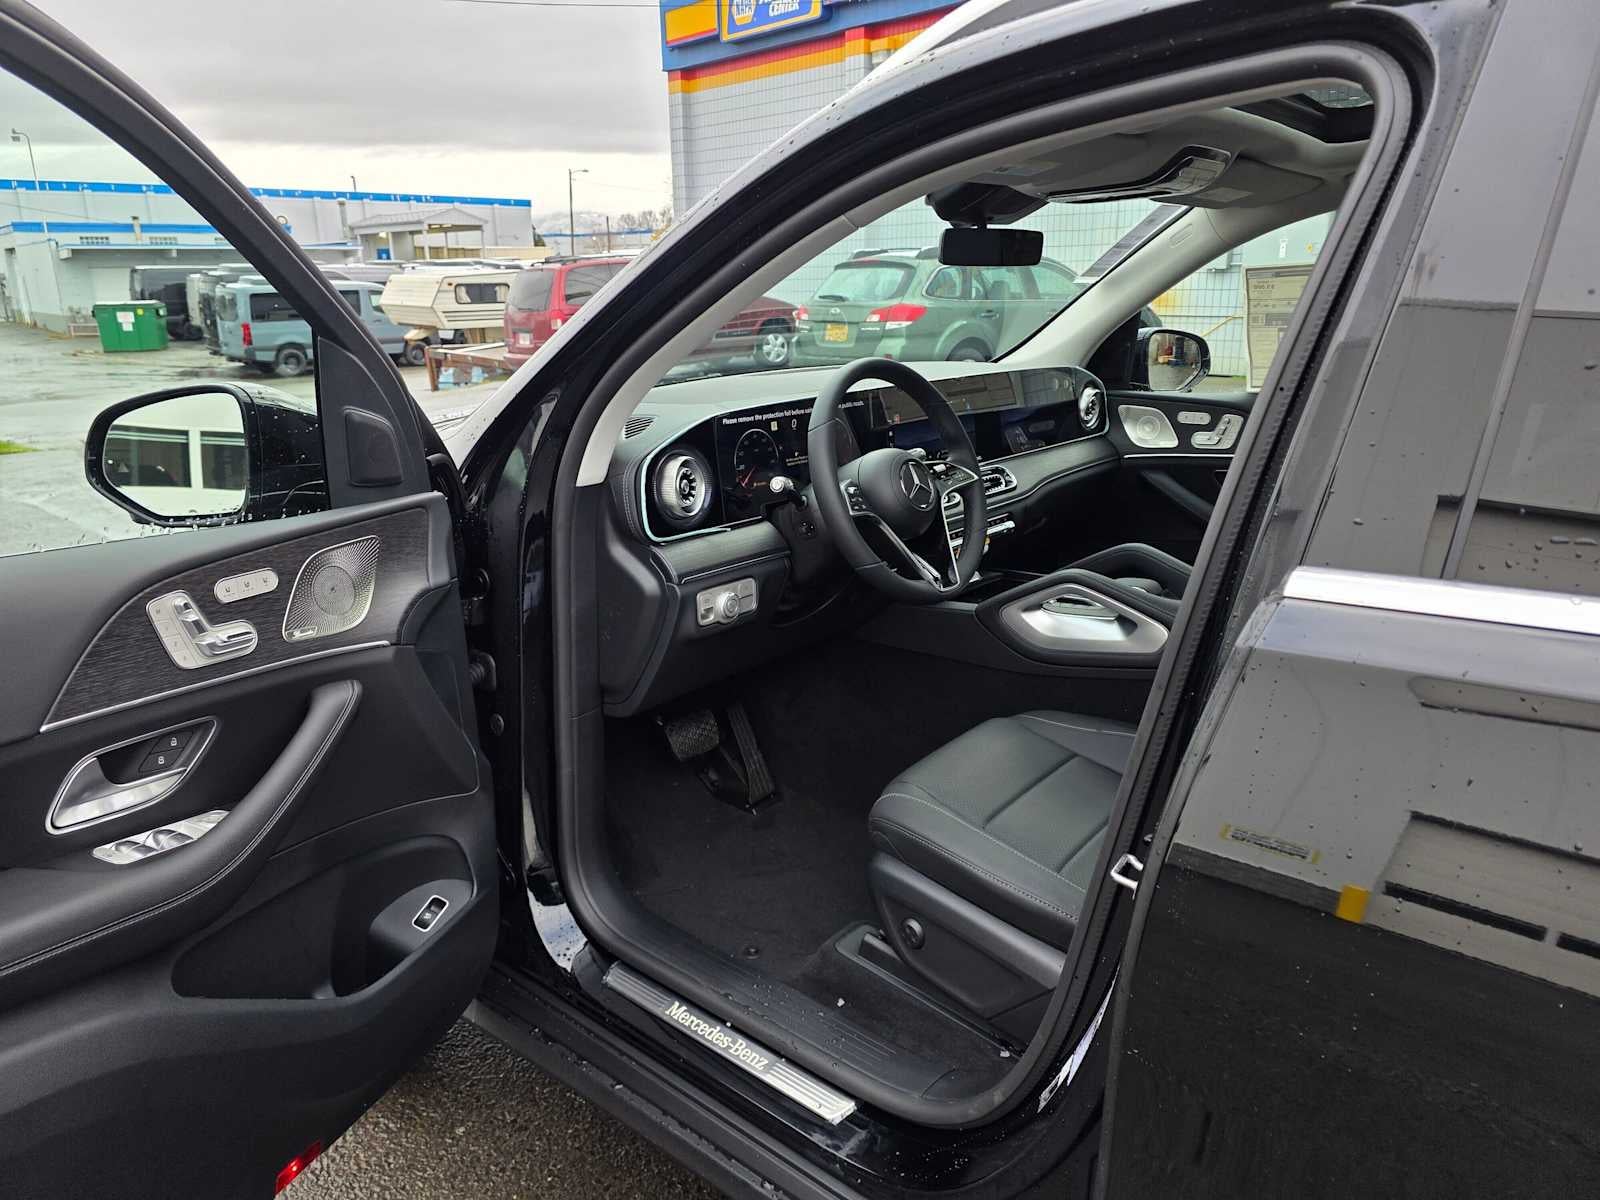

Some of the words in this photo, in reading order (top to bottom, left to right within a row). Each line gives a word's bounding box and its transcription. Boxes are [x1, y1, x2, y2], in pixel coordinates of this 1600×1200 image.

[768, 1, 800, 16] CENTER
[763, 411, 784, 420] protection
[792, 408, 804, 416] before
[665, 1001, 769, 1070] Mercedes-Benz
